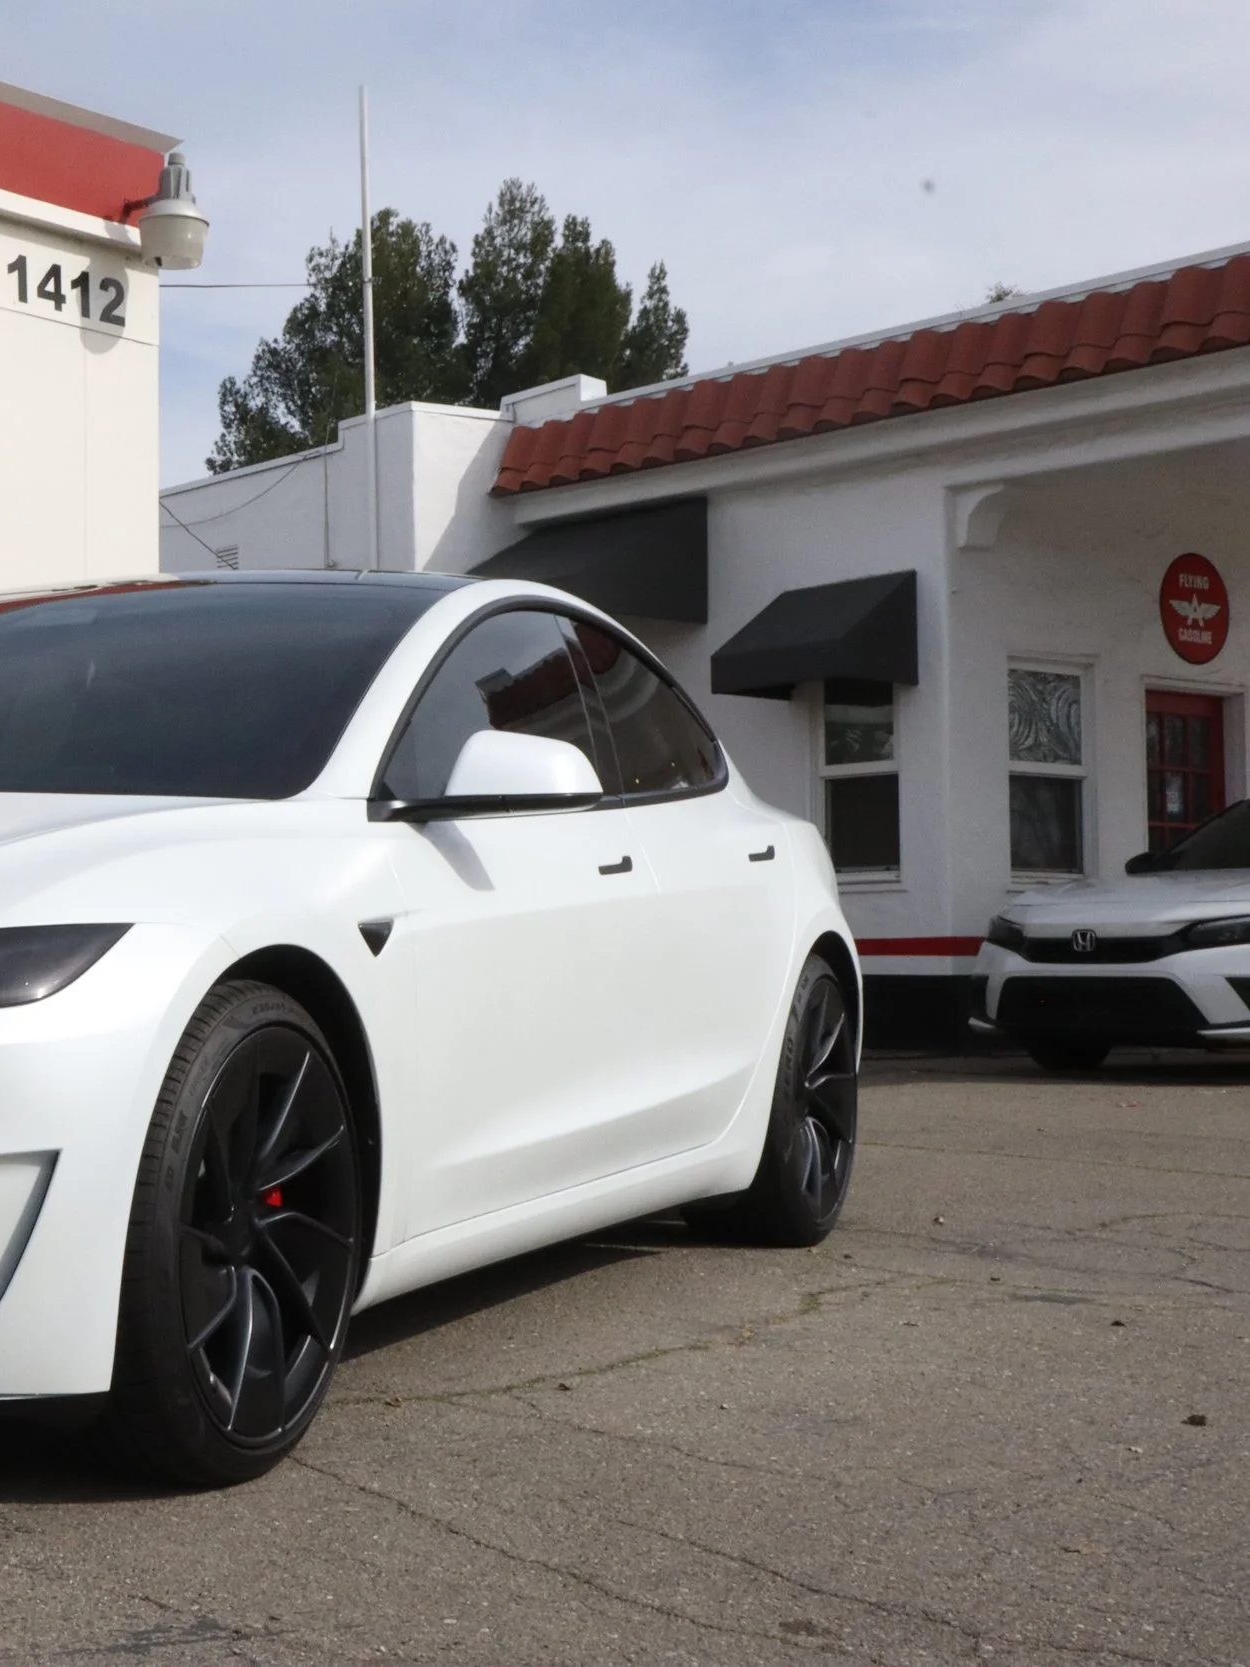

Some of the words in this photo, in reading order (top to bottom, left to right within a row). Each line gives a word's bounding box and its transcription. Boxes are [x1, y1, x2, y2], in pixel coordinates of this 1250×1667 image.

[7, 254, 127, 328] 1412
[1179, 574, 1209, 589] FLYING
[1179, 628, 1212, 645] GASOLINE
